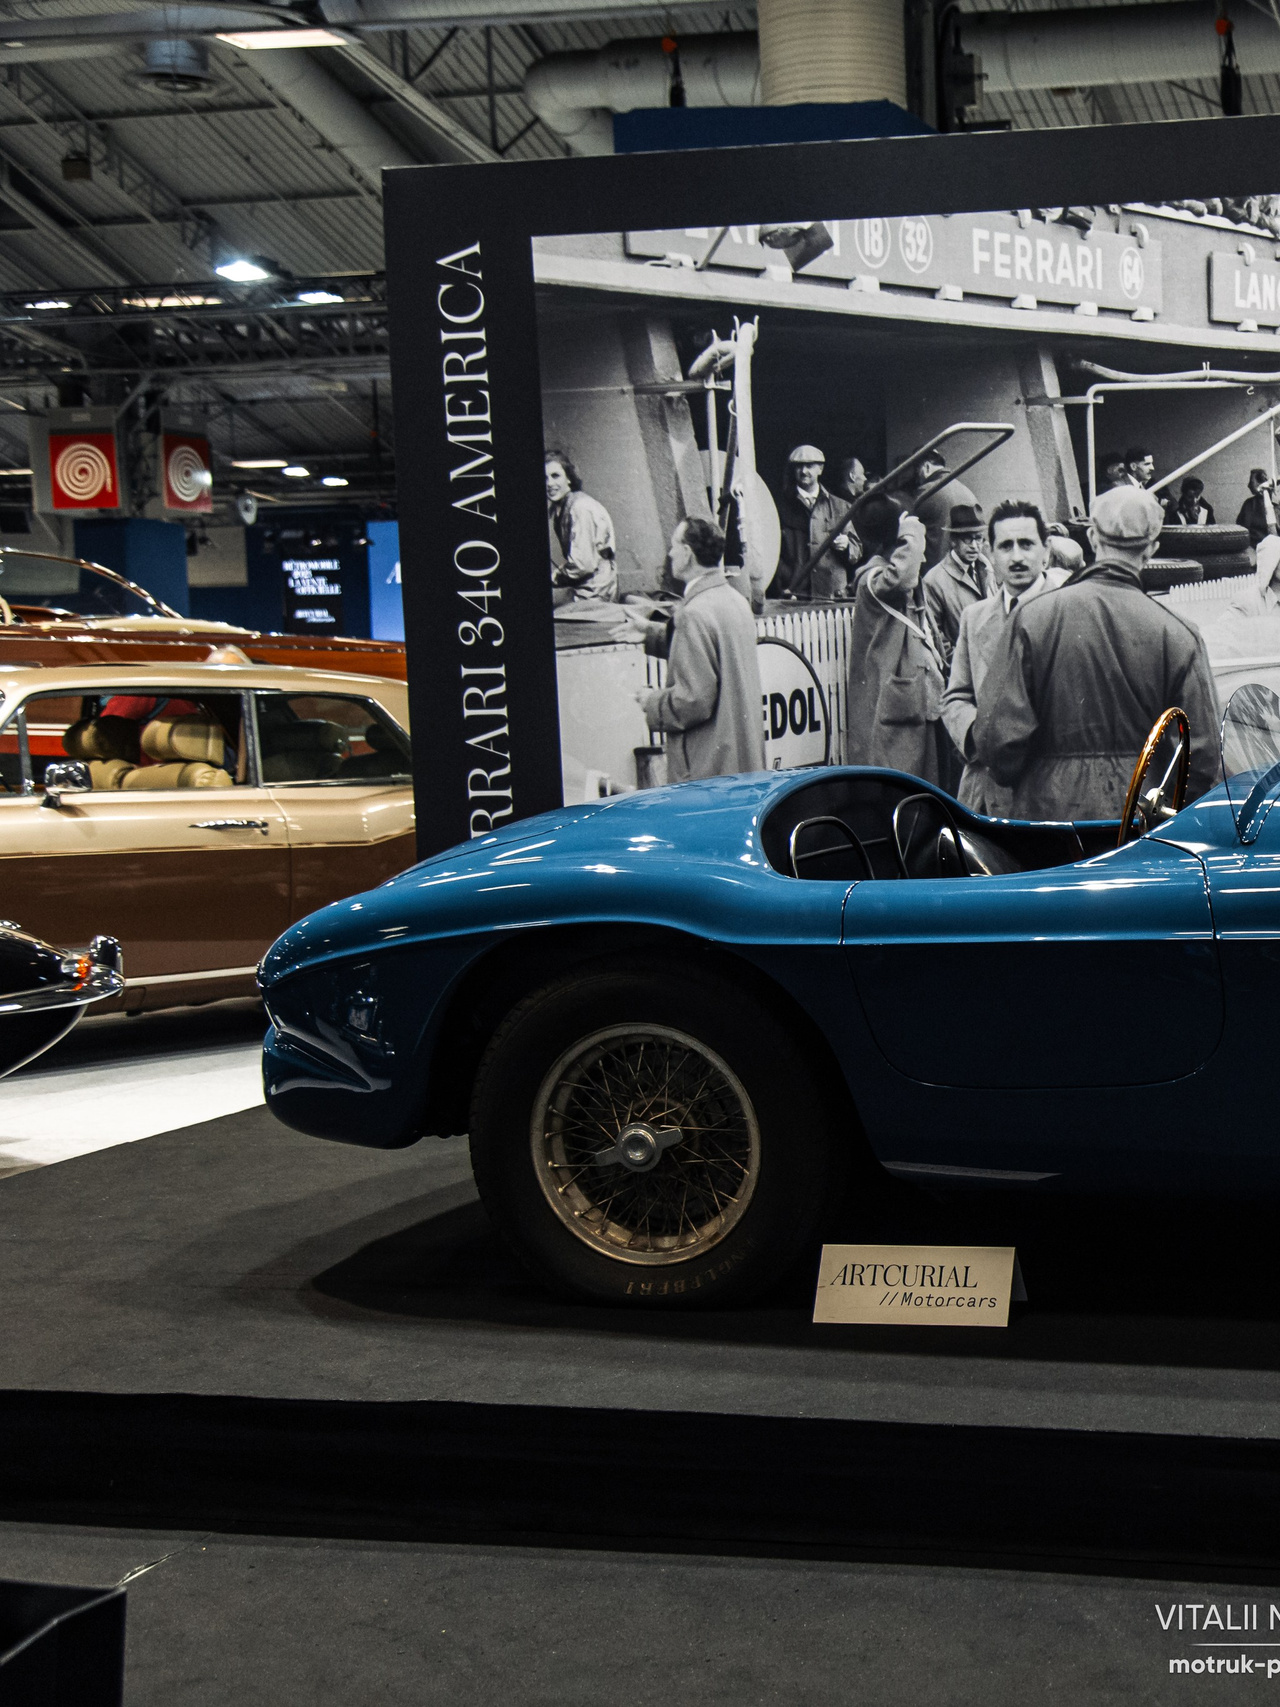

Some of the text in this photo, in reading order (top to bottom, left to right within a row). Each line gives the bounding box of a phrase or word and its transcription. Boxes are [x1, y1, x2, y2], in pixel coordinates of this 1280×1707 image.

[864, 218, 884, 258] 18
[971, 227, 1140, 291] FERRARI 64
[435, 239, 514, 839] RRARI 340 AMERICA
[762, 687, 821, 741] EDOL
[830, 1263, 978, 1288] ARTCURIAL
[879, 1291, 997, 1308] //Motorcars
